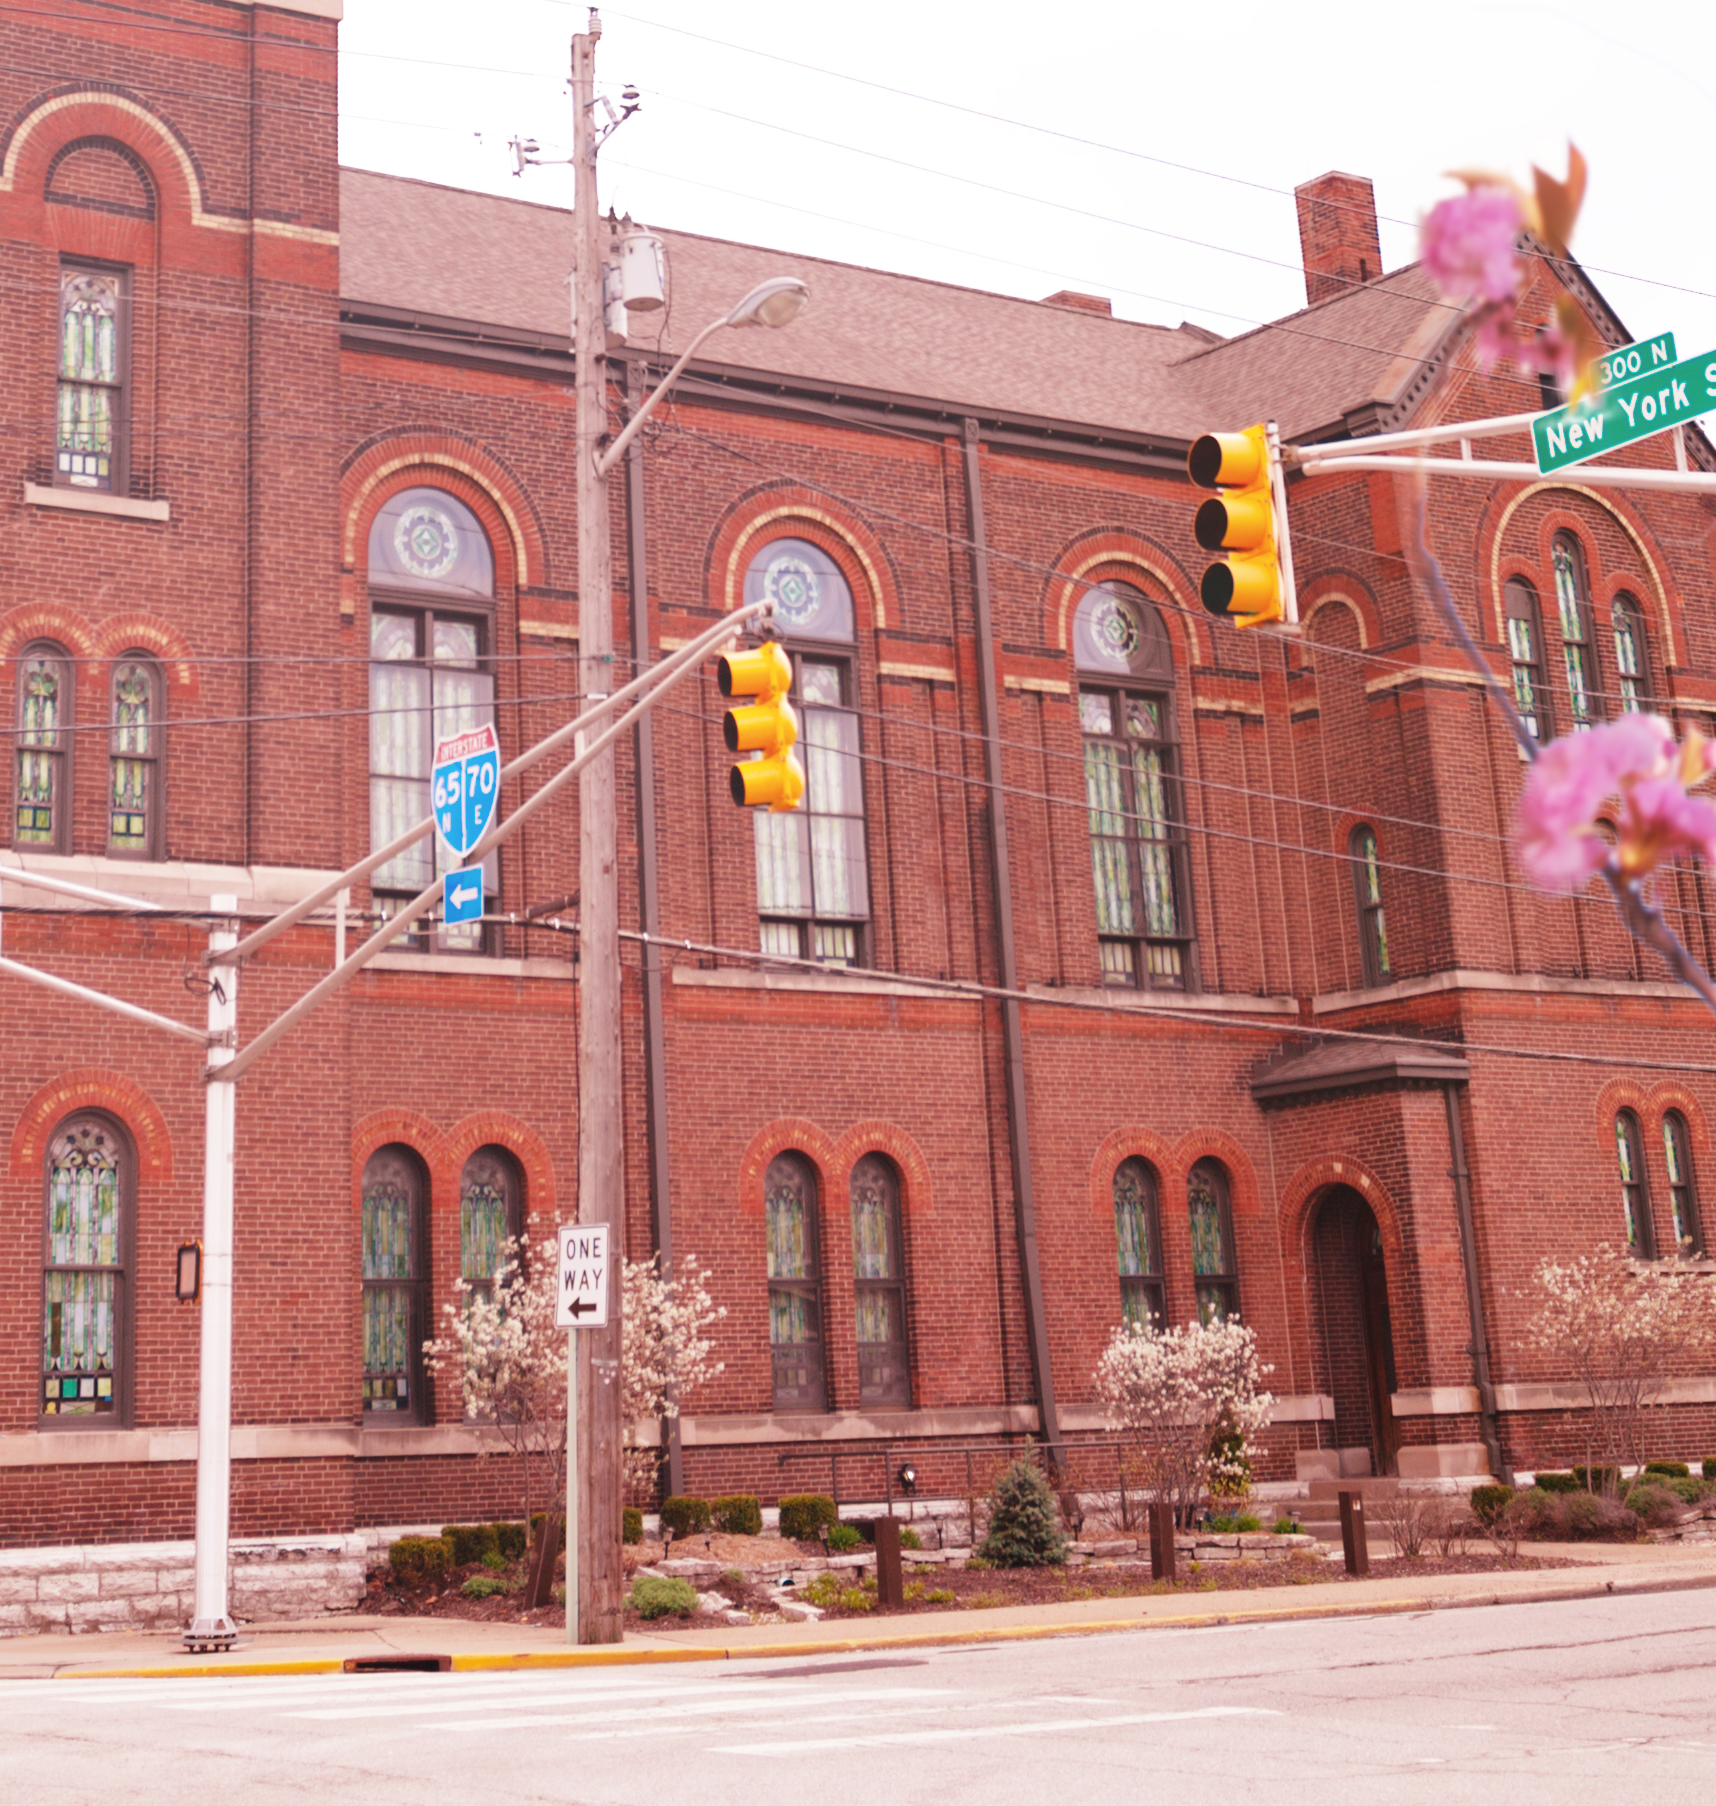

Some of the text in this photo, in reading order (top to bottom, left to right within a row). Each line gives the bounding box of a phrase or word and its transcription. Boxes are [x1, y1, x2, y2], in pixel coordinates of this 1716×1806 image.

[1599, 339, 1668, 385] 300 N
[1545, 413, 1605, 459] New
[1617, 378, 1690, 427] York
[440, 732, 489, 761] INTERSTATE
[435, 762, 494, 809] 65 70
[442, 804, 483, 834] N E
[566, 1237, 602, 1260] ONE
[564, 1268, 603, 1291] WAY
